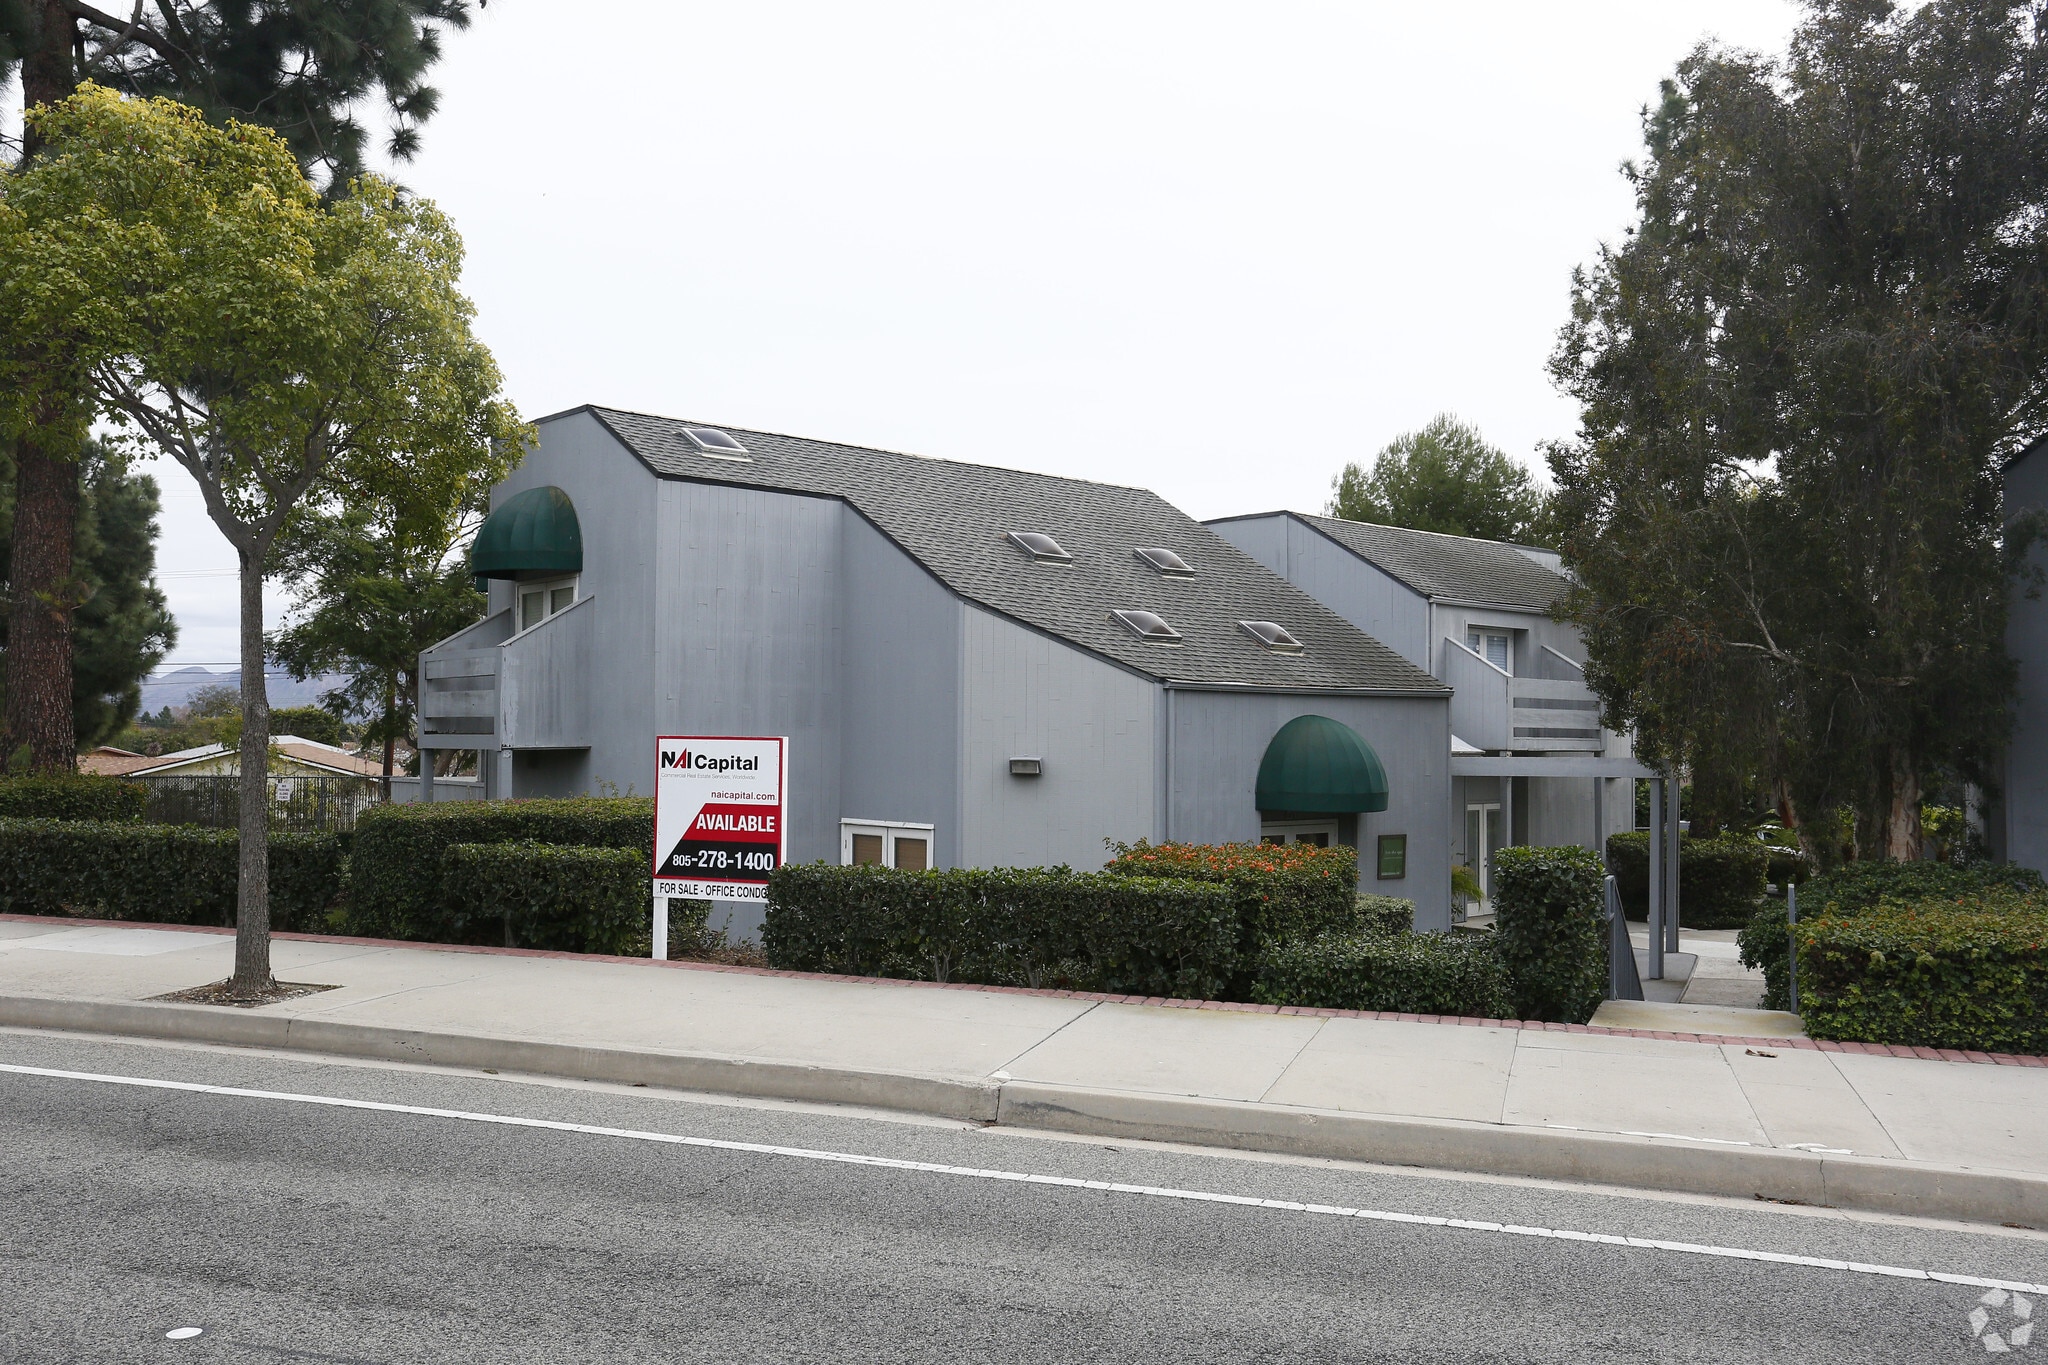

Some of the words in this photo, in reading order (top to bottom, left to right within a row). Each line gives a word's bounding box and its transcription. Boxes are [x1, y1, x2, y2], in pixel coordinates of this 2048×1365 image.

[661, 748, 692, 769] NAI
[694, 755, 758, 773] Capital
[711, 791, 775, 801] naicapital.com
[696, 814, 775, 832] AVAILABLE
[672, 850, 774, 870] 805-278-1400
[659, 882, 677, 894] FOR
[678, 883, 699, 895] SALE
[705, 884, 735, 897] OFFICE
